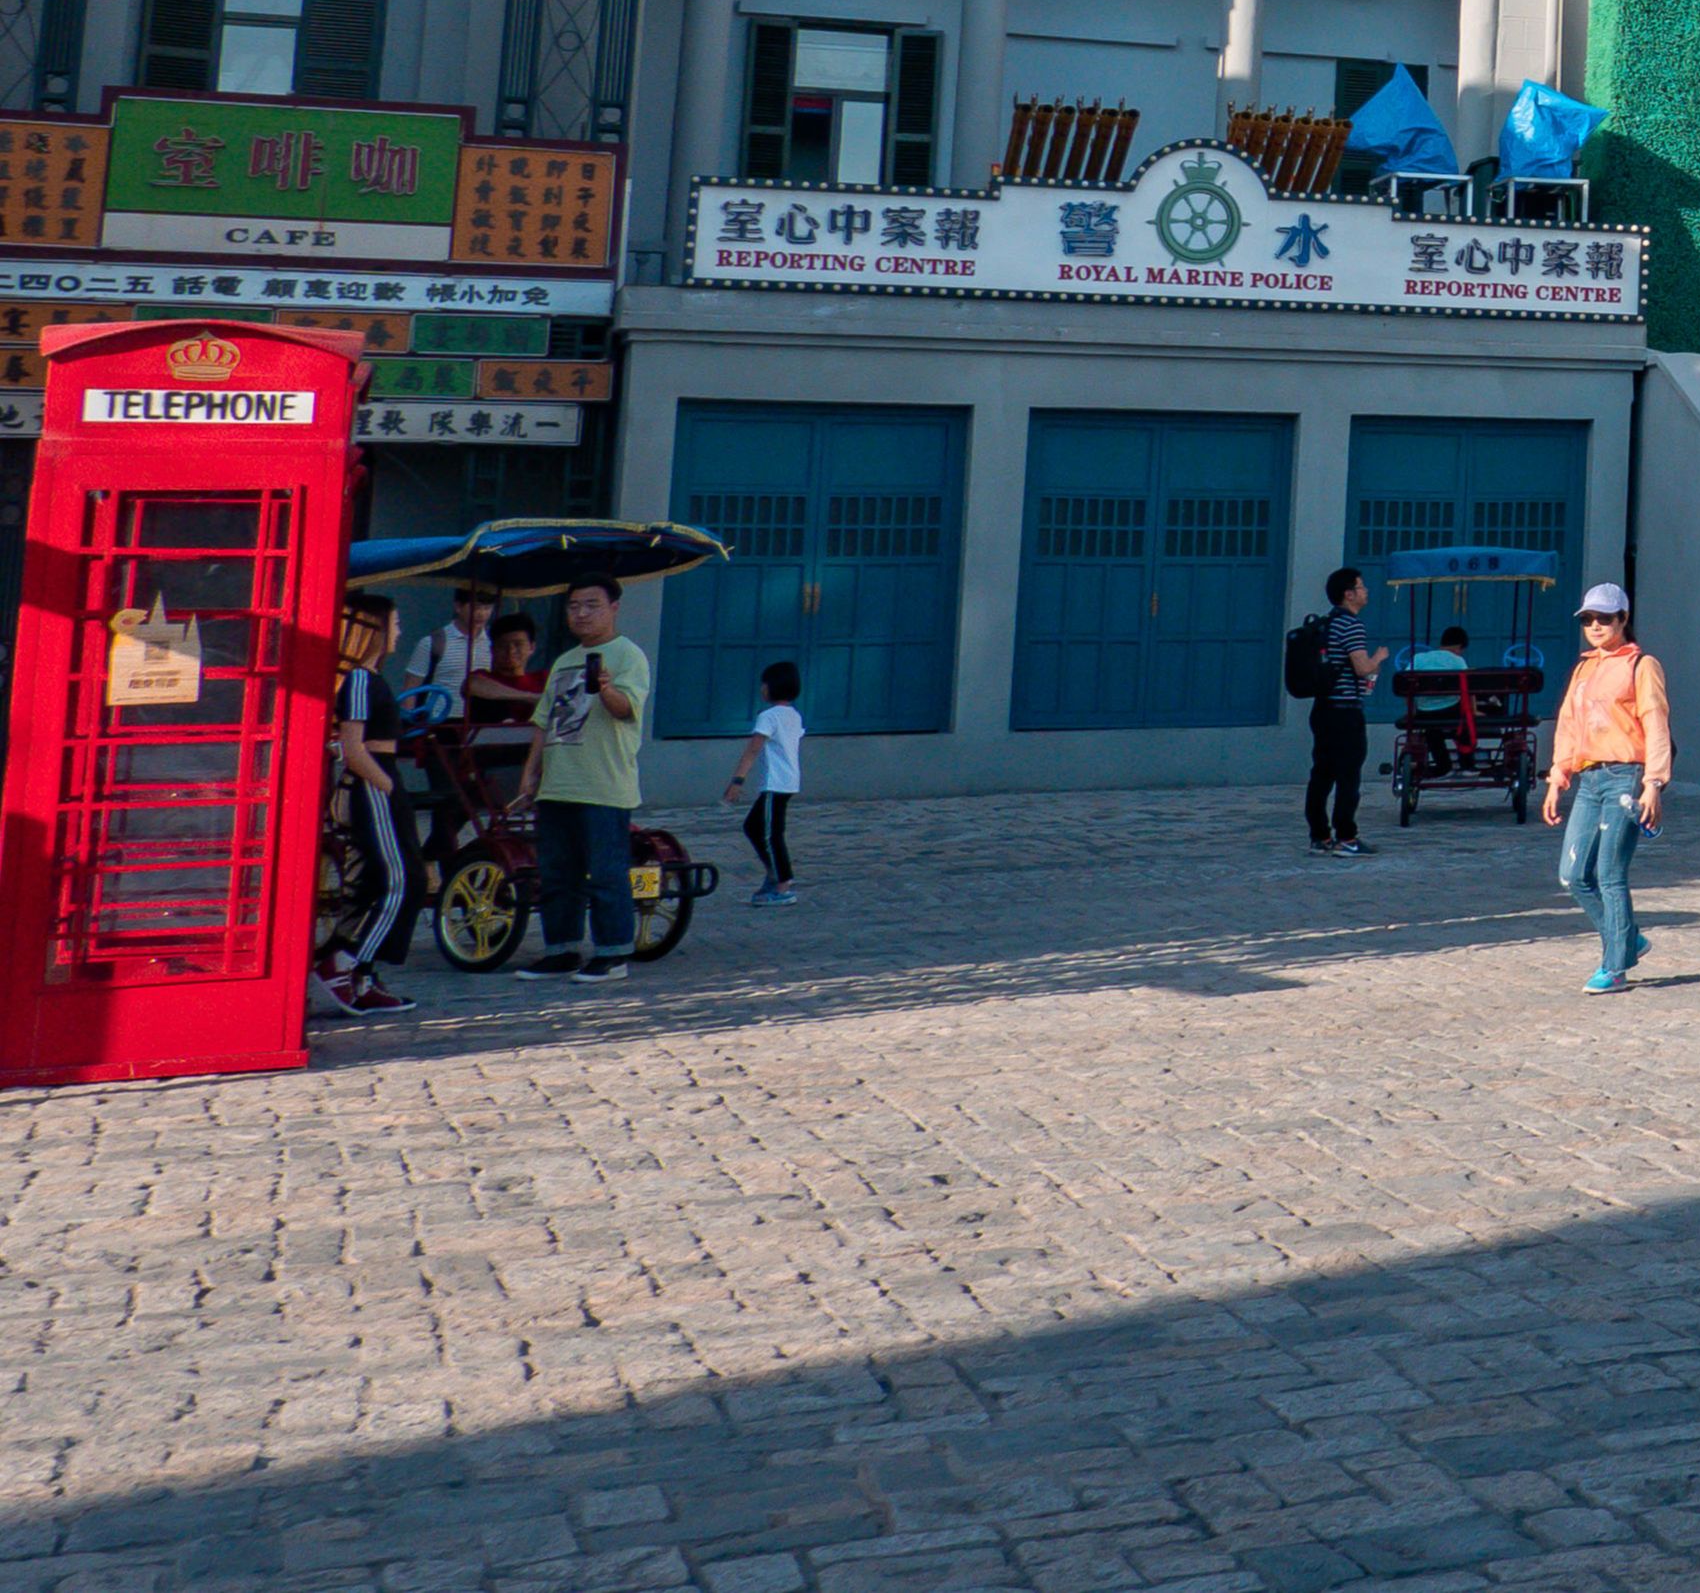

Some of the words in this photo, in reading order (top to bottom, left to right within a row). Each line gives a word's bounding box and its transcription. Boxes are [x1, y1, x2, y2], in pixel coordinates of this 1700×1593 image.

[225, 226, 337, 249] CAFE
[717, 250, 867, 276] REPORTING
[875, 254, 976, 277] CENTRE
[1058, 264, 1138, 287] ROYAL
[1145, 265, 1246, 291] MARINE
[1251, 270, 1334, 292] POLICE
[1403, 278, 1529, 301] REPORTING
[1535, 284, 1622, 303] CENTRE
[102, 391, 297, 421] TELEPHONE
